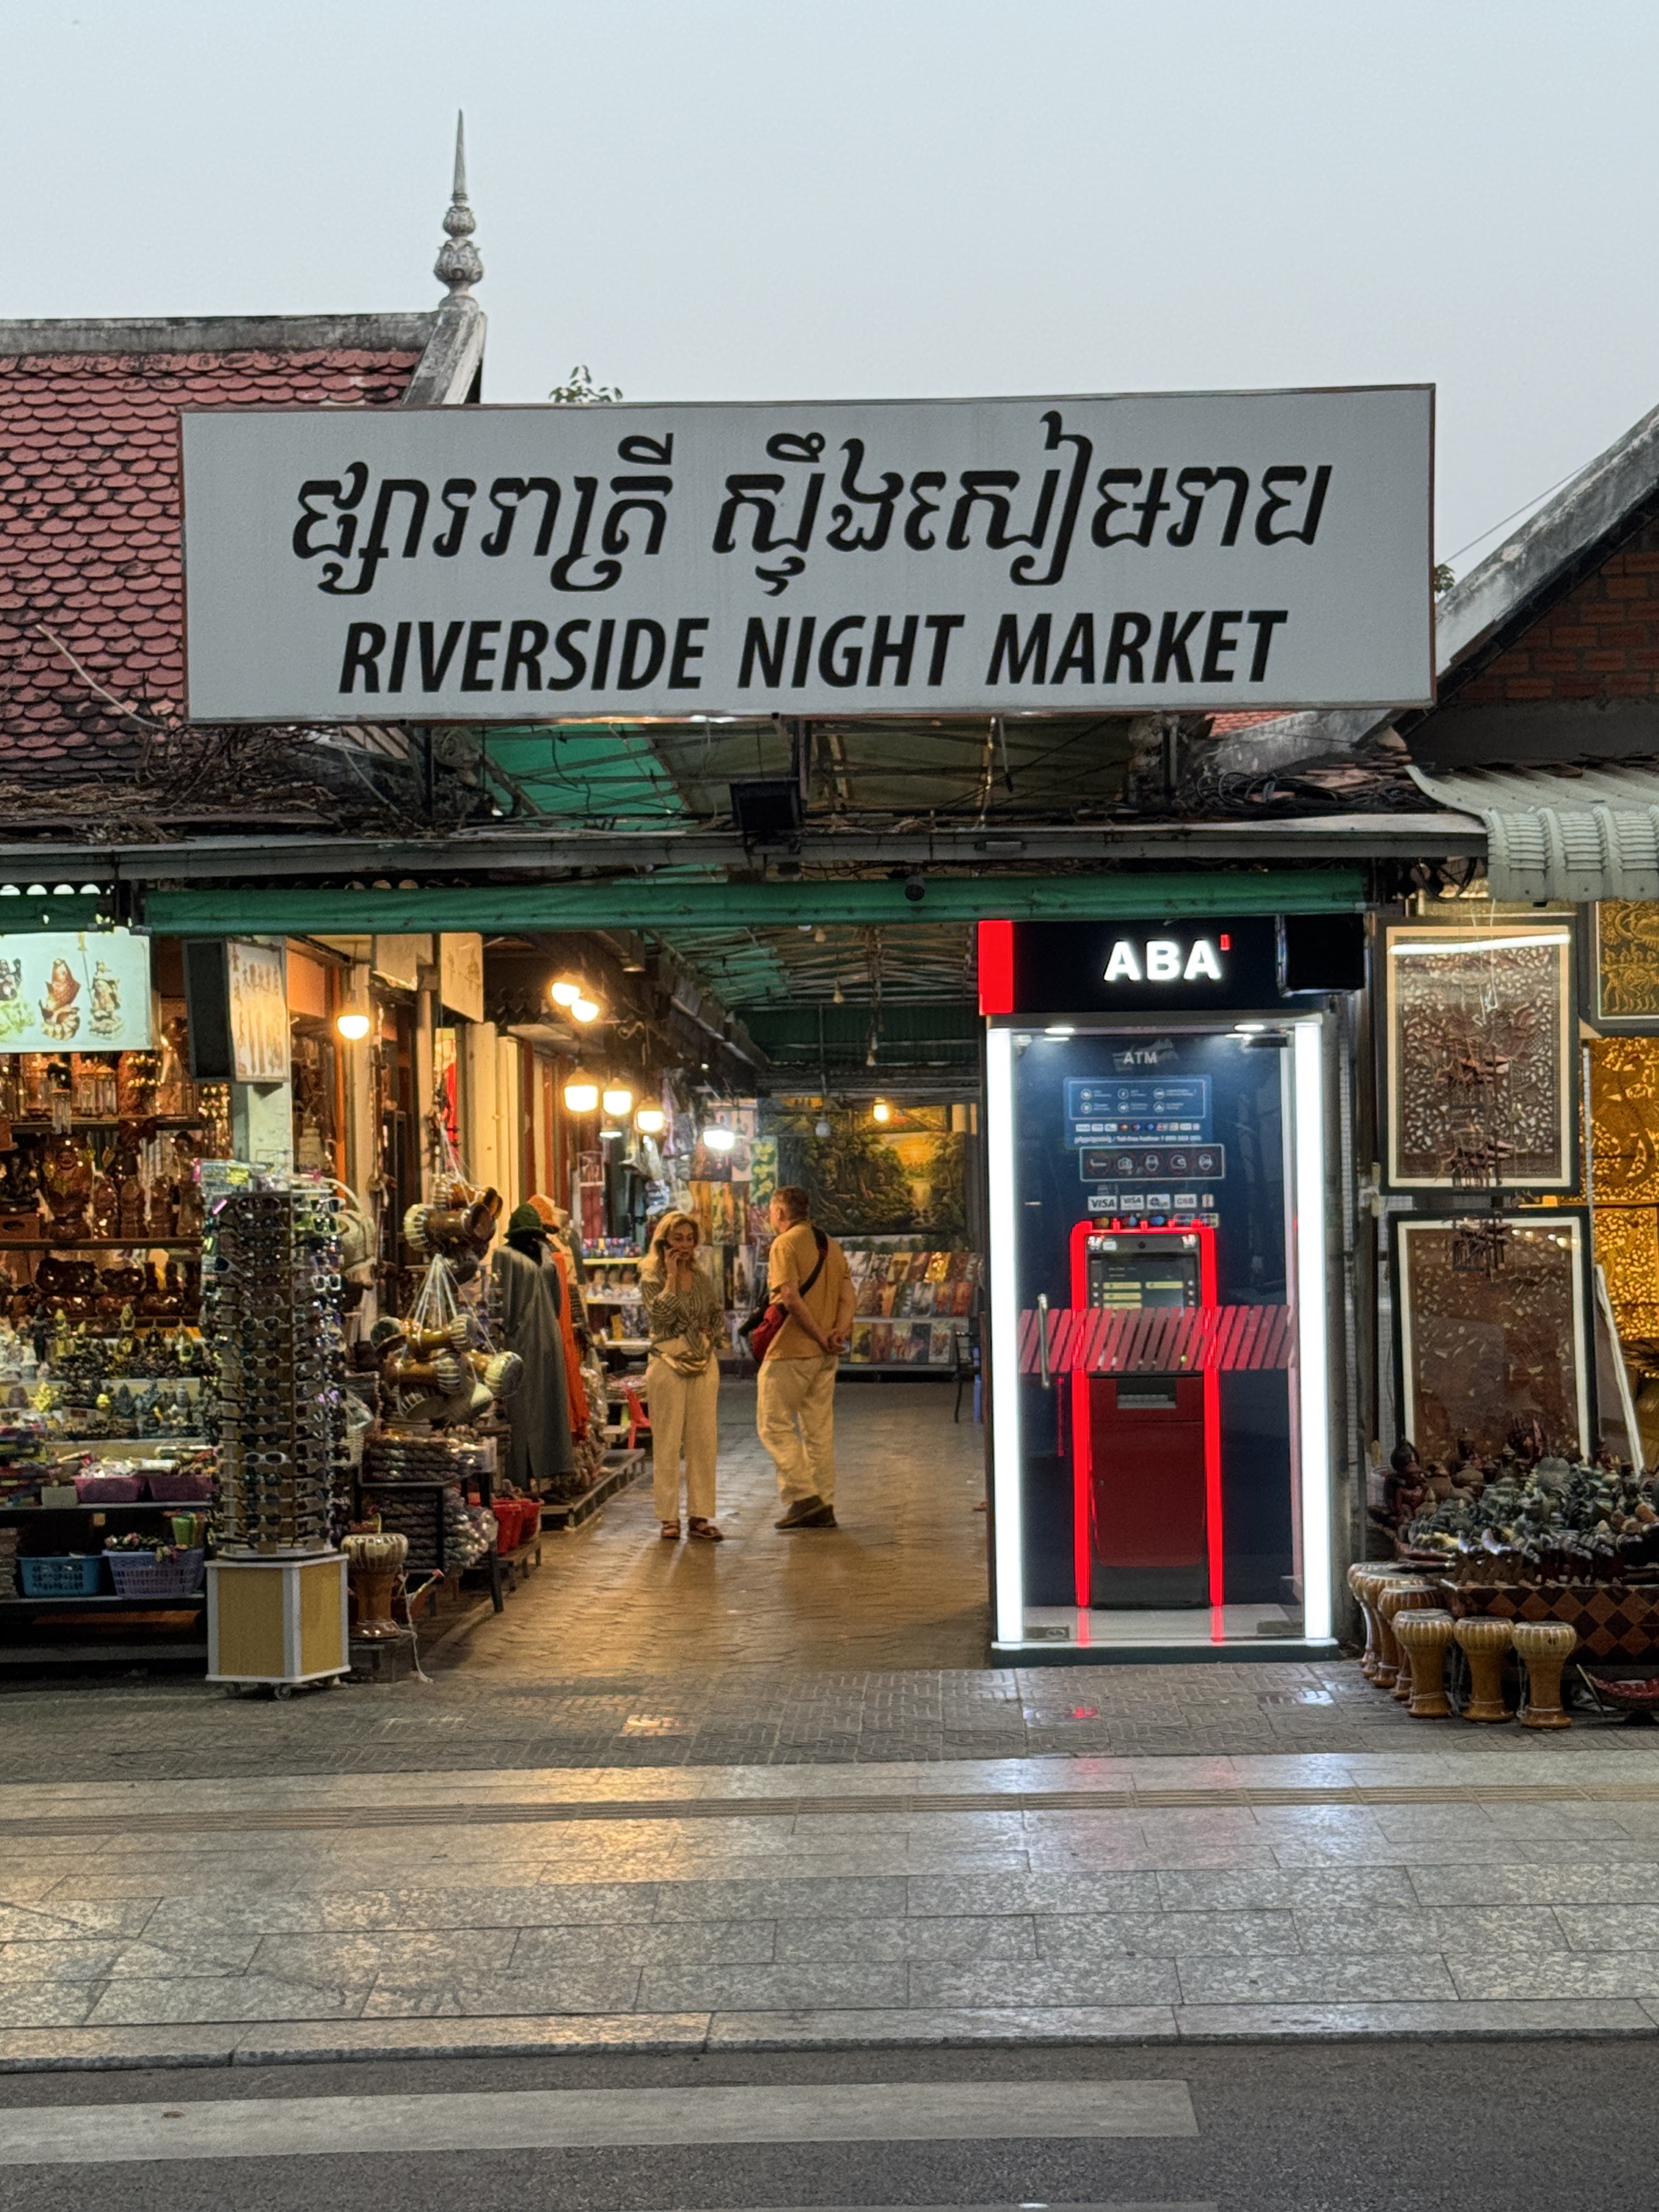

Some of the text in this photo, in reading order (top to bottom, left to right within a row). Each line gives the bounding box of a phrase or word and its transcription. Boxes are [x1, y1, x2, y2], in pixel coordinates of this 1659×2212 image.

[292, 432, 674, 596] ផ្សាររាត្រី
[338, 610, 1289, 692] RIVERSIDE NIGHT MARKET
[1104, 940, 1222, 981] ABA
[1124, 1051, 1158, 1064] ATM
[1091, 1199, 1115, 1208] VISA
